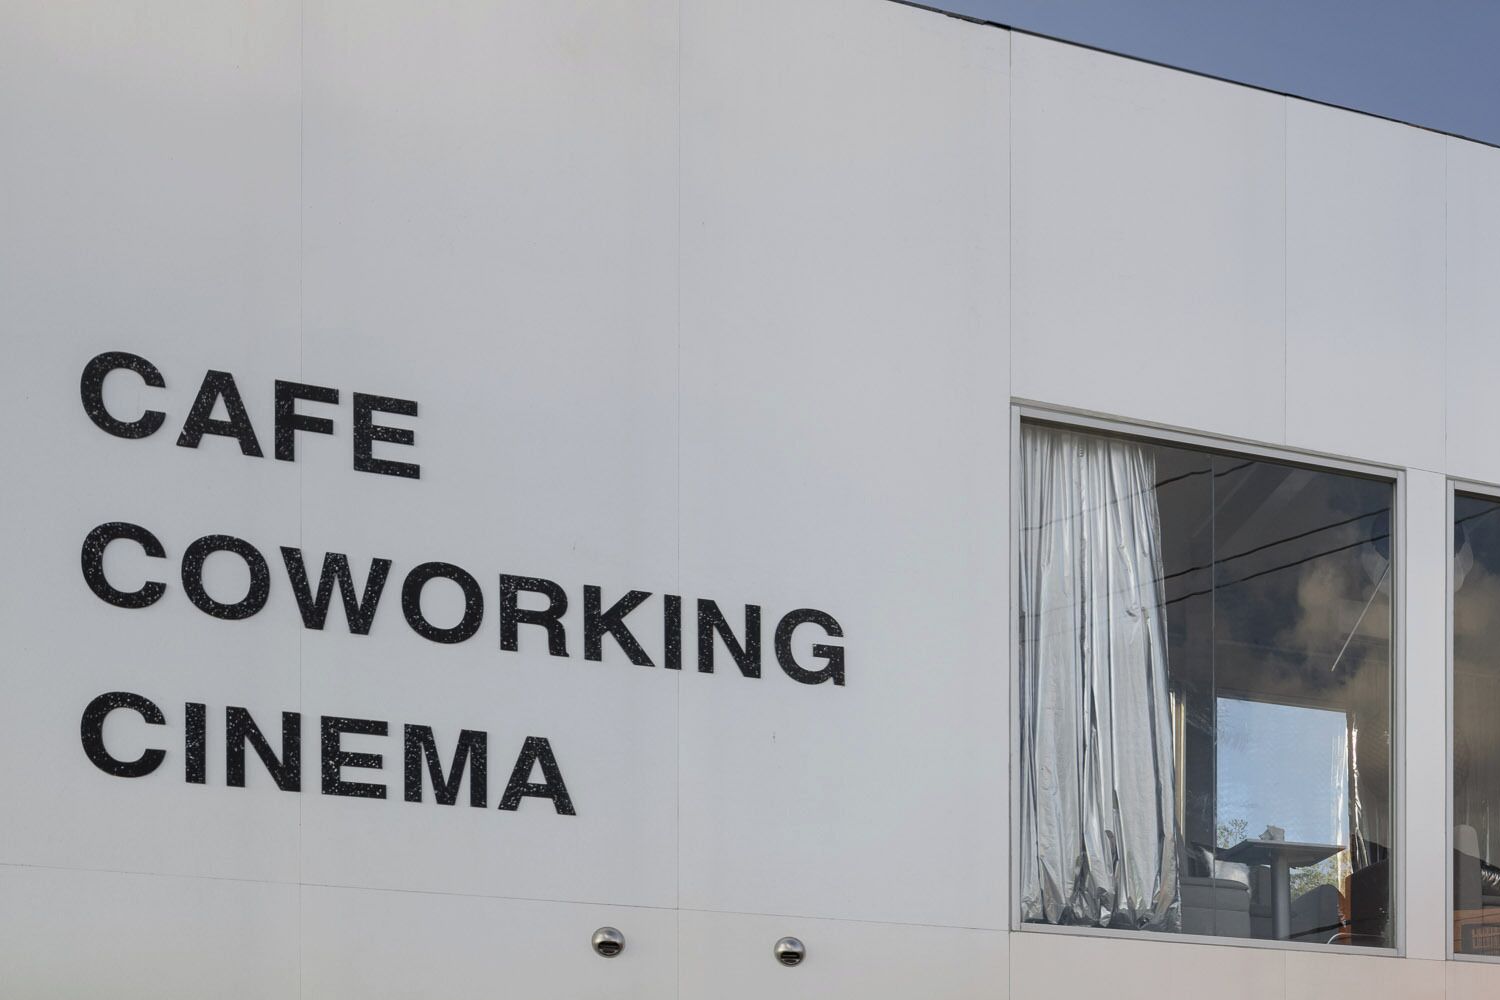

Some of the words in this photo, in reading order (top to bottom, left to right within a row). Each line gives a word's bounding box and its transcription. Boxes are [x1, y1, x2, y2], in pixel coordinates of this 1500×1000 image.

[81, 352, 420, 479] CAFE
[81, 522, 845, 686] COWORKING
[81, 692, 576, 815] CINEMA
